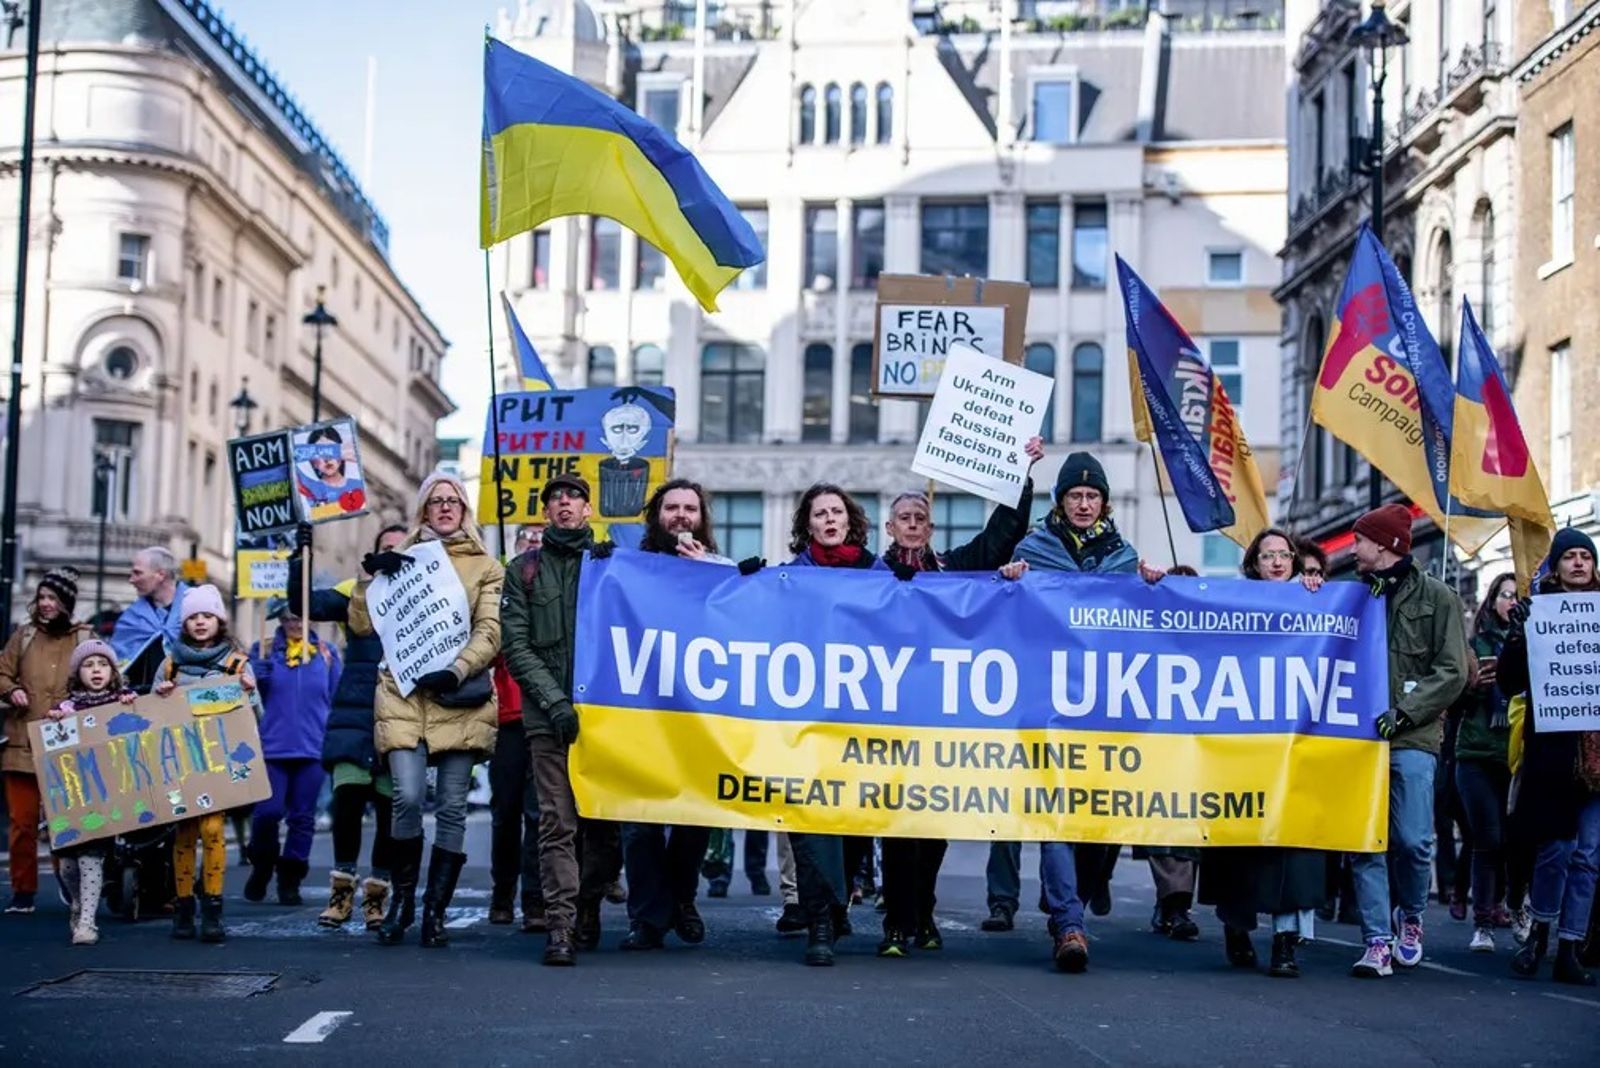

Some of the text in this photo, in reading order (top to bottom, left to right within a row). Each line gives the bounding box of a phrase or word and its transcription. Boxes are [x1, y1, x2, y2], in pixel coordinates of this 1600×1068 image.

[898, 310, 976, 336] FEAR
[887, 332, 985, 356] BRiNS
[883, 360, 917, 386] NO
[981, 368, 1016, 390] Arm
[499, 395, 575, 423] PUT
[952, 375, 1035, 415] Ukraine to
[963, 399, 1015, 427] defeat
[950, 412, 1017, 446] Russian
[235, 438, 286, 472] ARM
[938, 426, 1019, 465] fascism &
[529, 456, 582, 479] THE
[925, 442, 1021, 485] imperialism
[246, 499, 292, 529] NOW
[498, 487, 541, 518] Bi
[376, 560, 440, 617] Ukraine to
[395, 583, 434, 622] defeat
[395, 597, 450, 643] Russian
[1069, 607, 1360, 636] UKRAINE SOLIDARITY CAMPAIGN
[1559, 600, 1595, 614] Arm
[395, 610, 464, 663] fascism &
[1555, 640, 1600, 655] defea
[610, 625, 1359, 727] VICTORY TO UKRAINE
[1550, 661, 1600, 676] Russi
[1538, 703, 1600, 720] imperia
[841, 737, 1142, 773] ARM UKRAINE TO
[44, 748, 109, 813] ARM
[717, 773, 1266, 819] DEFEAT RUSSIAN IMPERIALISM!
